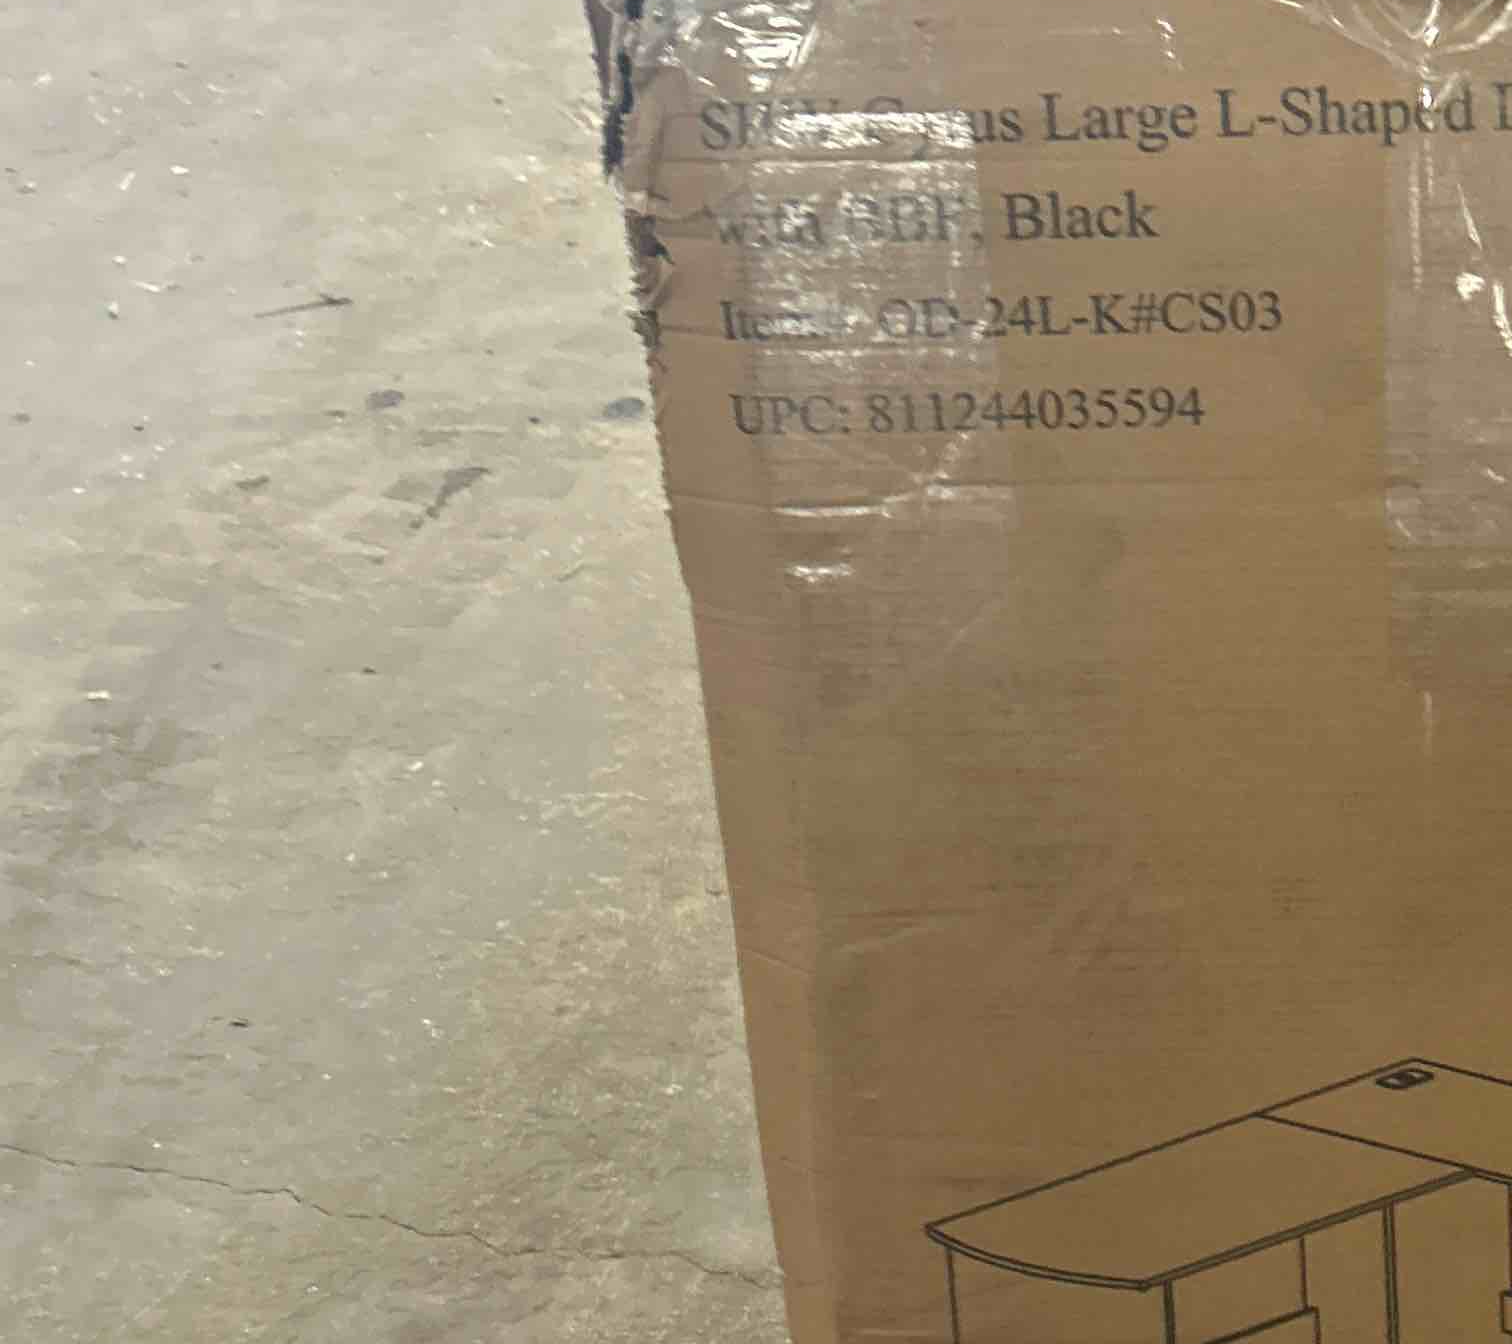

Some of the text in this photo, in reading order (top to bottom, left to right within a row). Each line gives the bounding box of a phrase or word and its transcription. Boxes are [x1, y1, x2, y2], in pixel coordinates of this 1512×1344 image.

[1038, 92, 1197, 153] Large
[1214, 84, 1475, 146] L-Shaped
[1003, 190, 1160, 241] Black
[728, 385, 1206, 436] UPC: 811244035594
